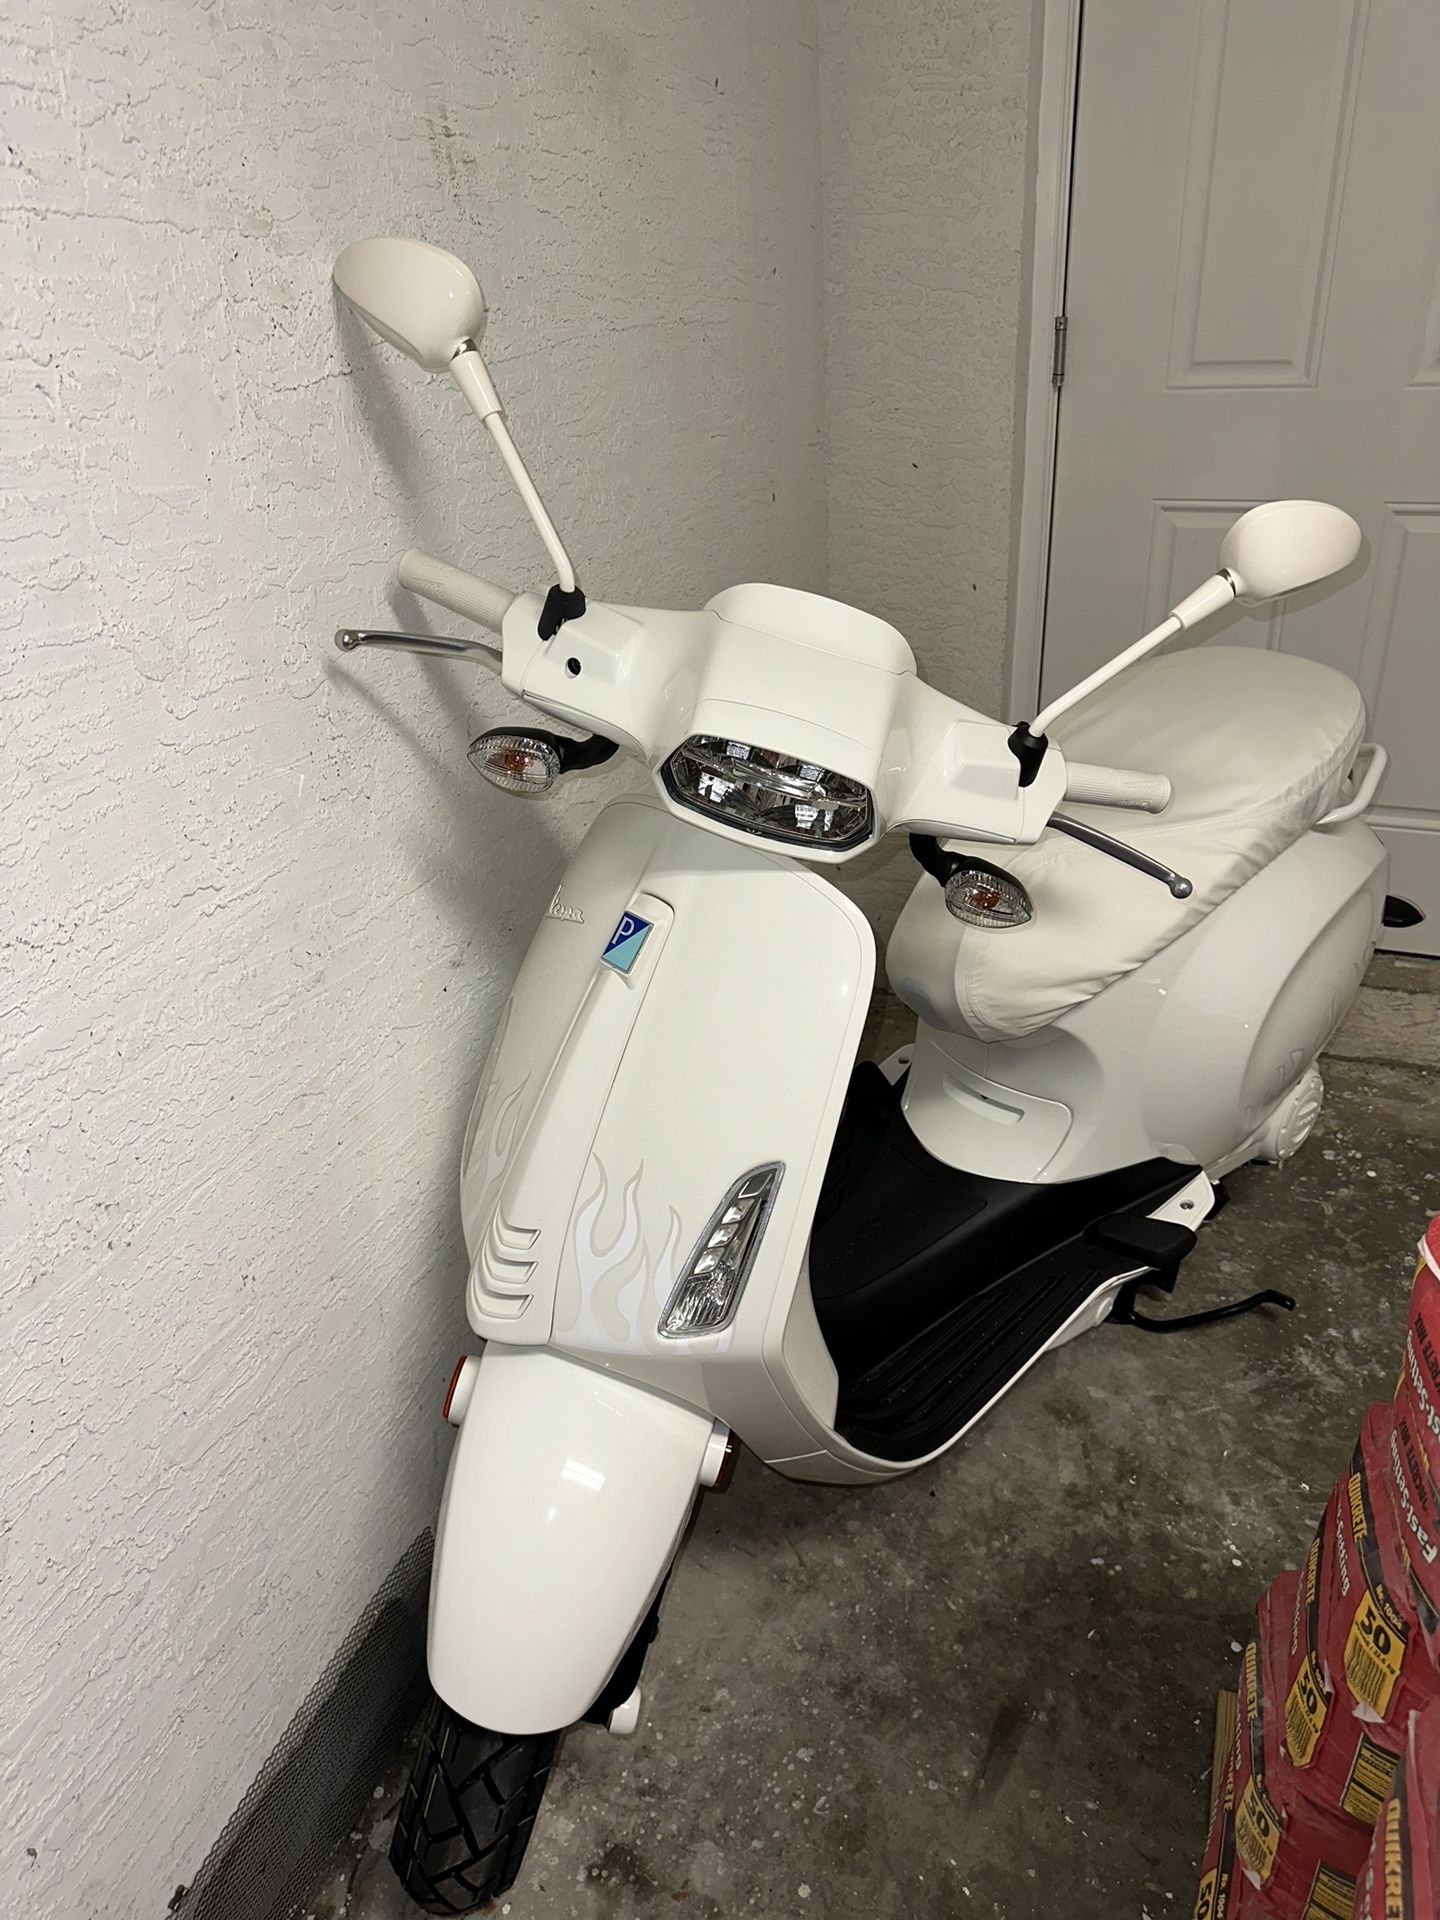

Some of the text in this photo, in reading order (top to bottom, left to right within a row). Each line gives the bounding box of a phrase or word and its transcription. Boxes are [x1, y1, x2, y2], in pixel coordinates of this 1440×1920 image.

[611, 915, 635, 945] P
[1348, 1471, 1368, 1543] QUIKRETE
[1305, 1538, 1319, 1605] QUIKRETE
[1360, 1605, 1392, 1655] 50
[1246, 1641, 1257, 1722] QUIKRETE
[1300, 1669, 1318, 1715] 50
[1250, 1789, 1270, 1838] 50
[1197, 1882, 1212, 1920] 50
